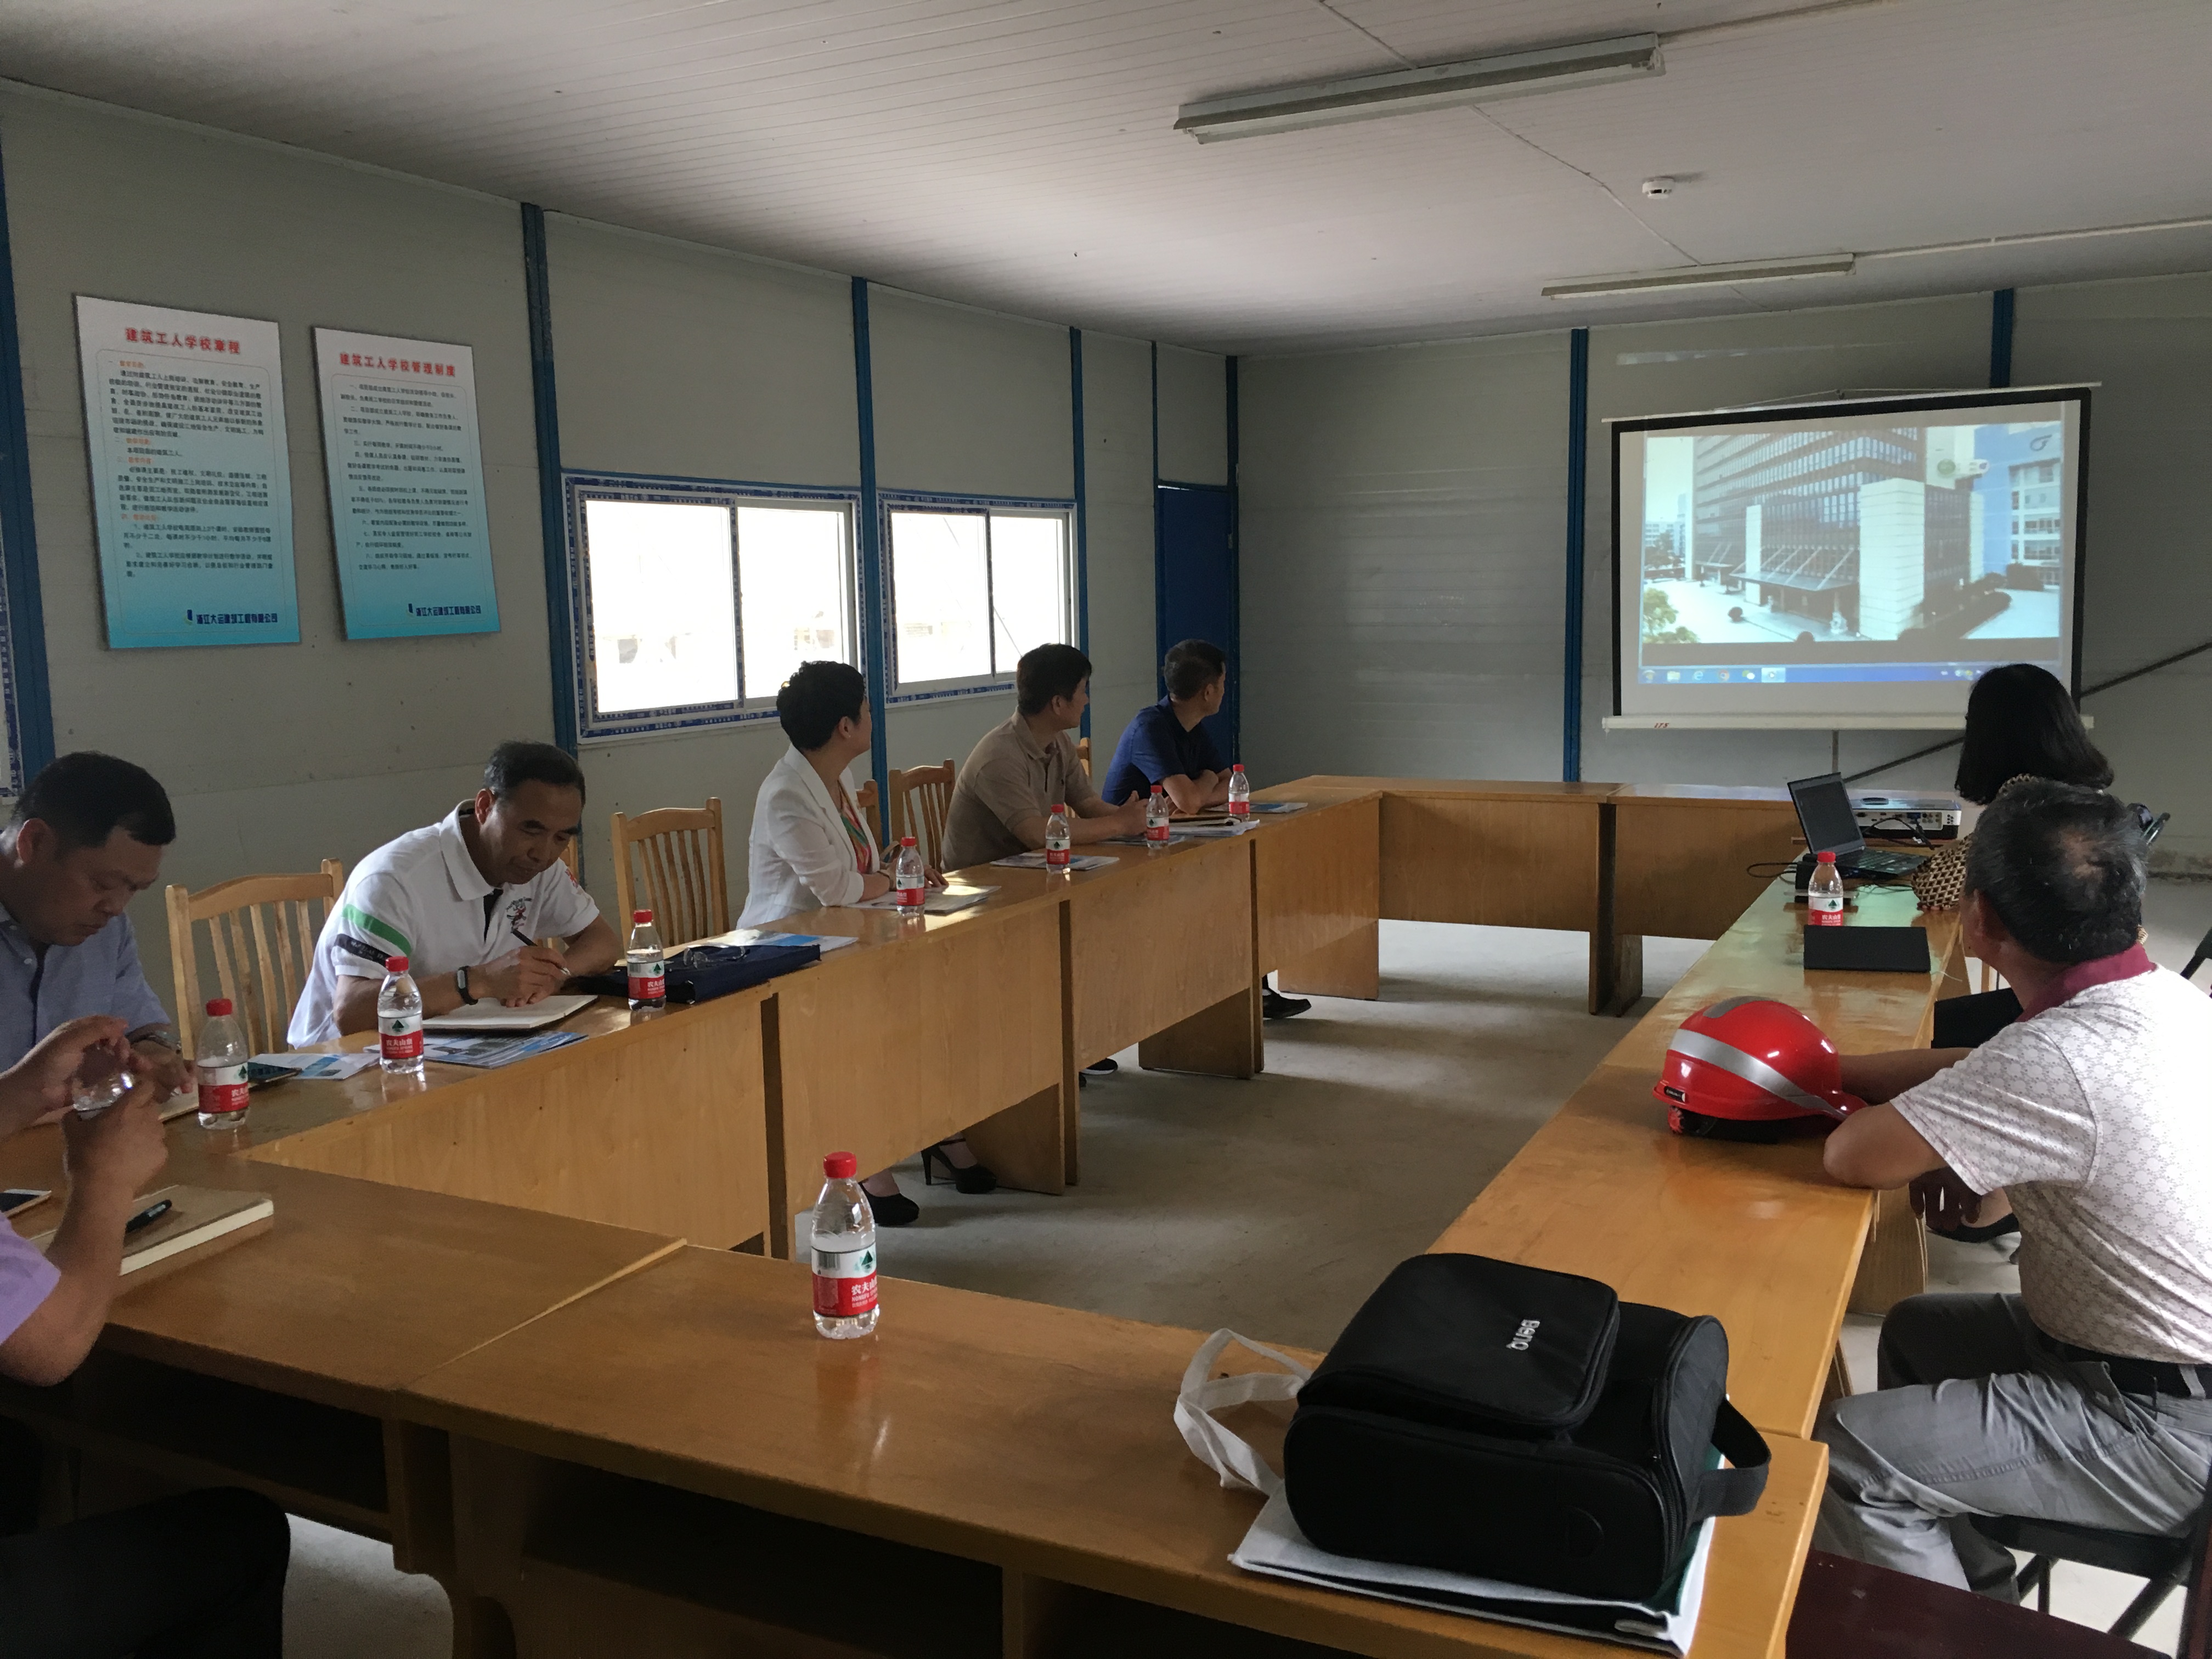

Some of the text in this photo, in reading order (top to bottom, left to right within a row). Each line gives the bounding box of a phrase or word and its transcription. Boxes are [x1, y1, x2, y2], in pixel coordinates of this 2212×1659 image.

[126, 328, 239, 354] 建筑工人学校章程
[340, 352, 455, 376] 建筑工人学校管理制度
[1506, 1319, 1541, 1351] BenQ
